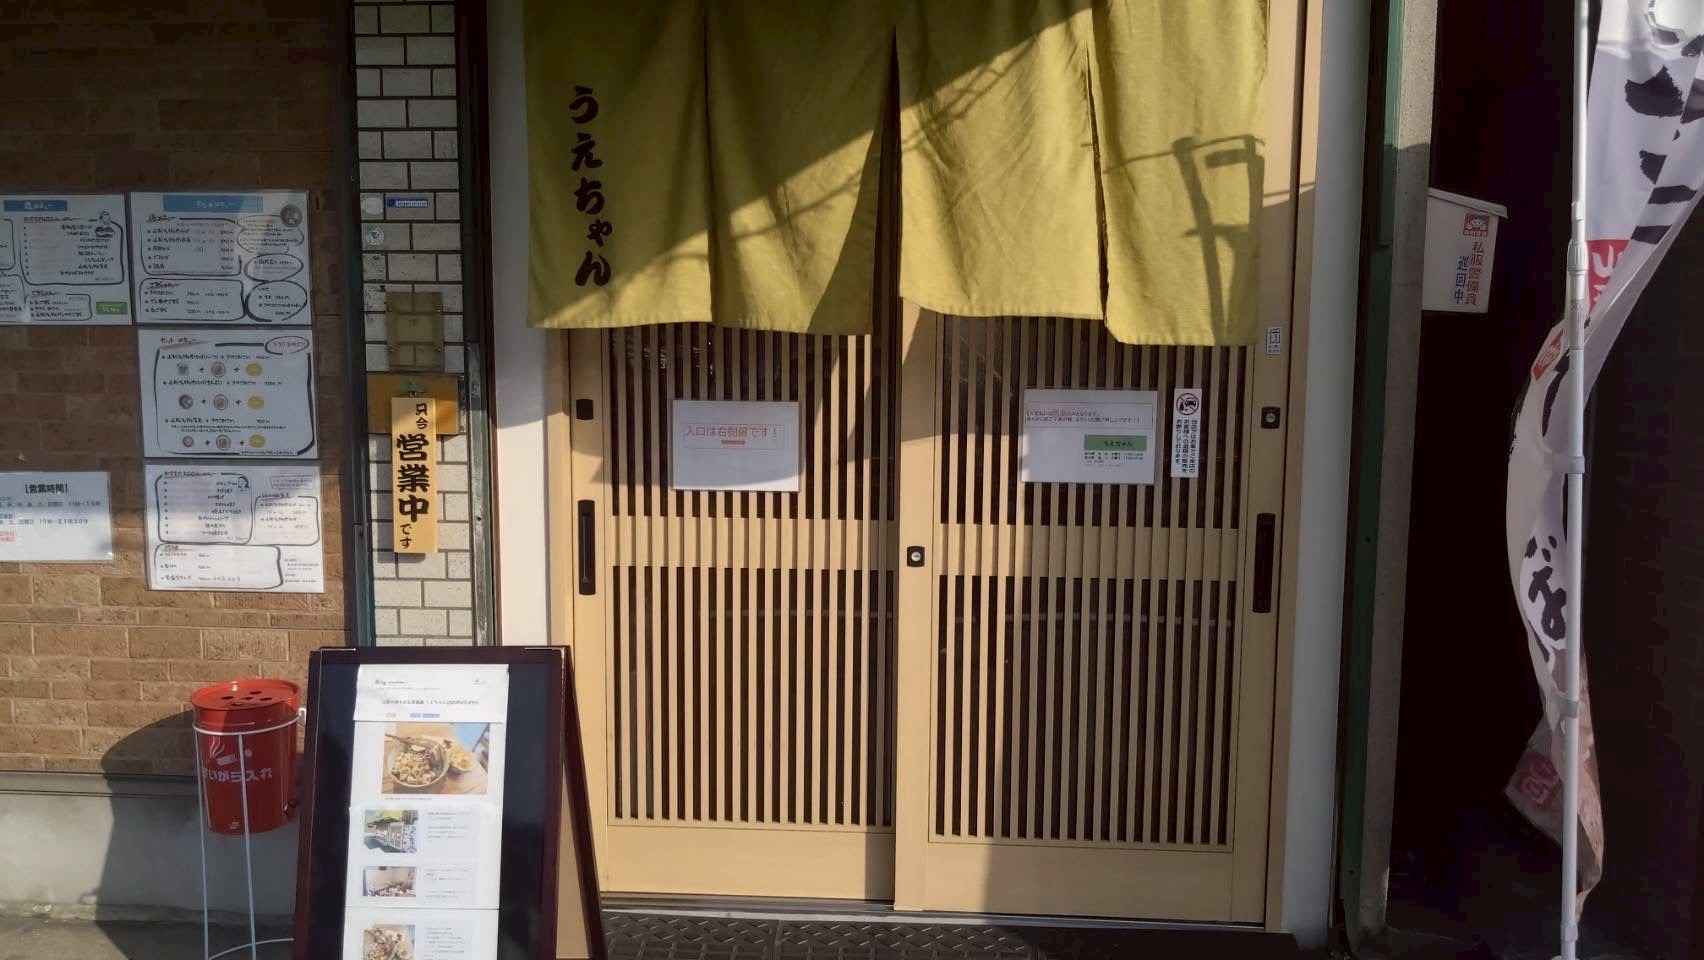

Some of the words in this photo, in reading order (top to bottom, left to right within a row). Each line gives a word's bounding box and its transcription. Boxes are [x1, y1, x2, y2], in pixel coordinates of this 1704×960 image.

[568, 85, 613, 287] うえちゃん
[25, 483, 68, 494] 【営業時間】
